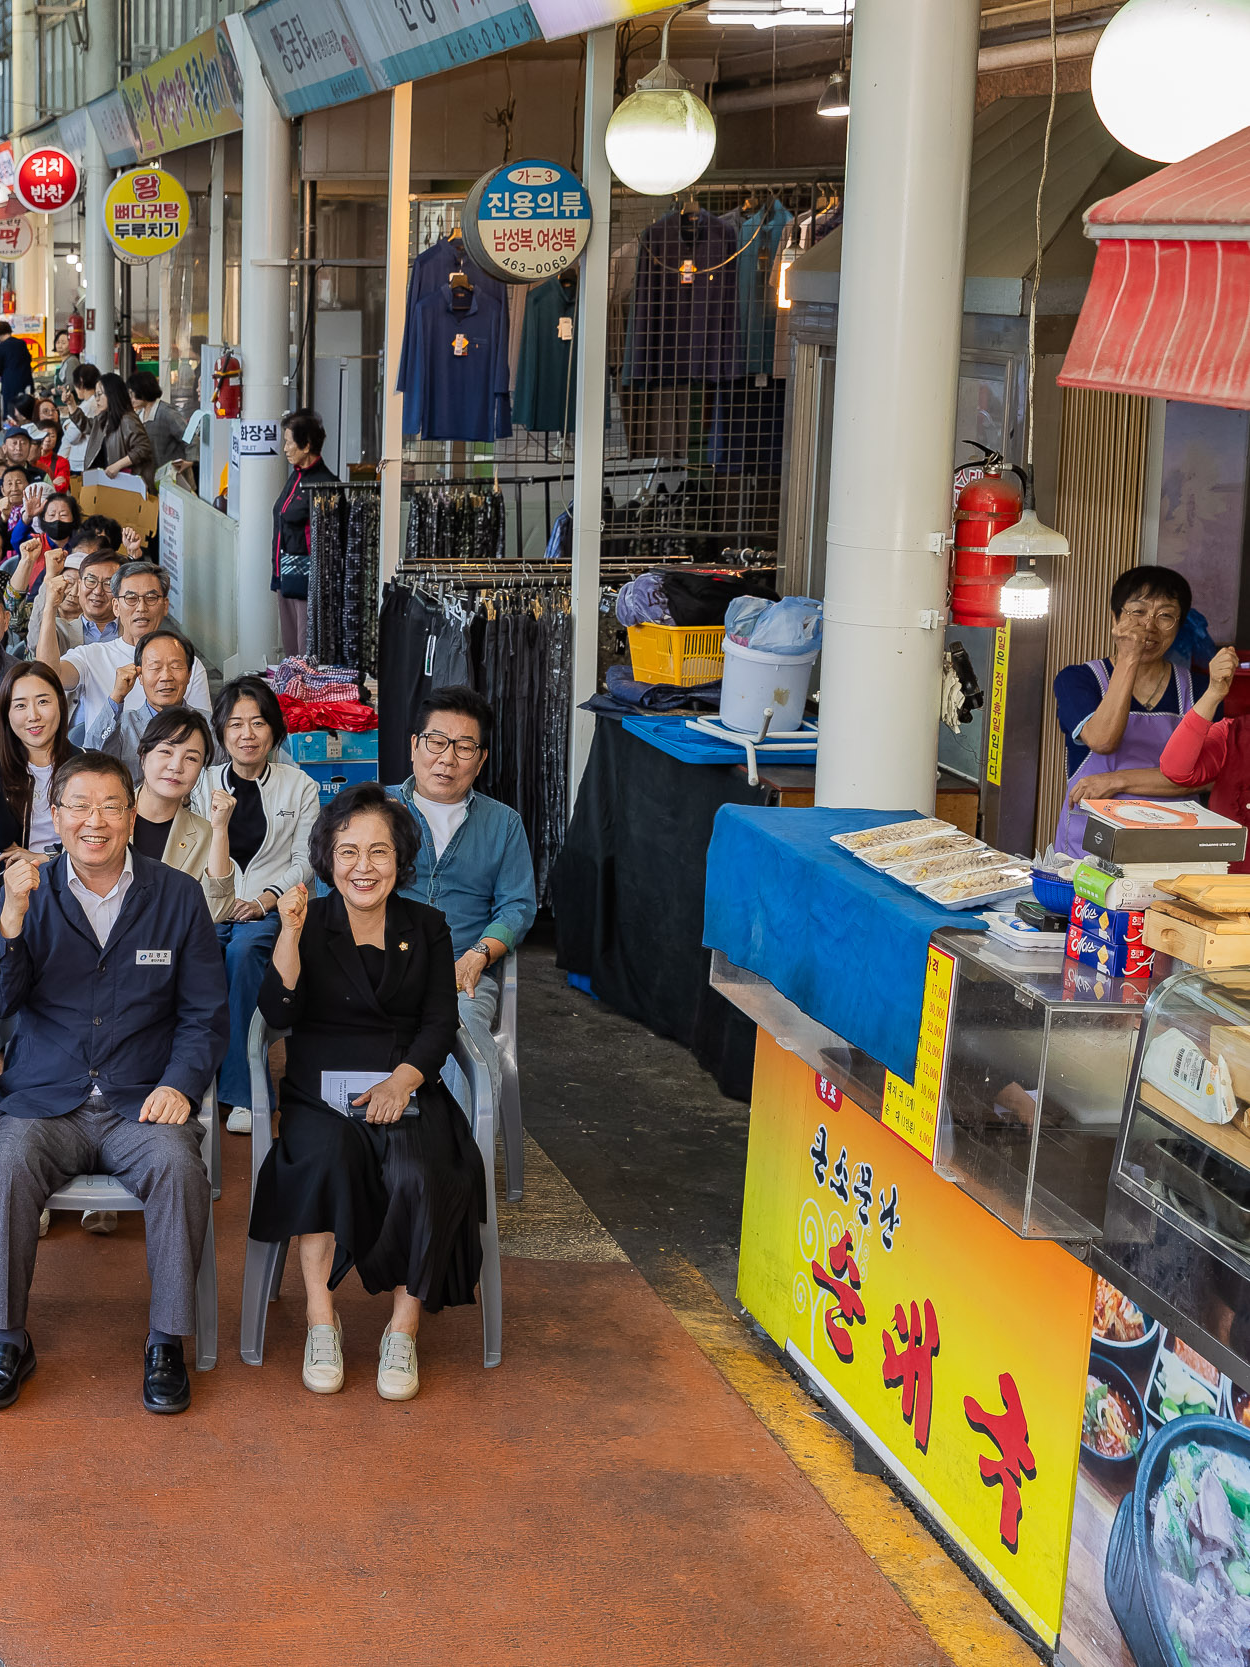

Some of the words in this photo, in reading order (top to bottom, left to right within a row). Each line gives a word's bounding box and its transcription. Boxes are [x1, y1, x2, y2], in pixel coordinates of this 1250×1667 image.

[30, 157, 64, 177] 김치
[517, 169, 553, 184] 가-3
[30, 184, 65, 203] 반찬
[133, 174, 159, 201] 왕
[114, 203, 180, 219] 뼈다귀탕
[487, 191, 584, 218] 진용의류
[0, 227, 20, 249] 떡
[114, 222, 180, 239] 두루치기
[502, 255, 568, 274] 463-0069
[240, 424, 277, 441] 화장실
[932, 983, 948, 1001] 17,000
[927, 1020, 943, 1039] 22,000
[925, 1039, 941, 1059] 12,000
[922, 1062, 939, 1081] 12,000
[921, 1107, 934, 1125] 6,000
[919, 1130, 932, 1147] 4,000
